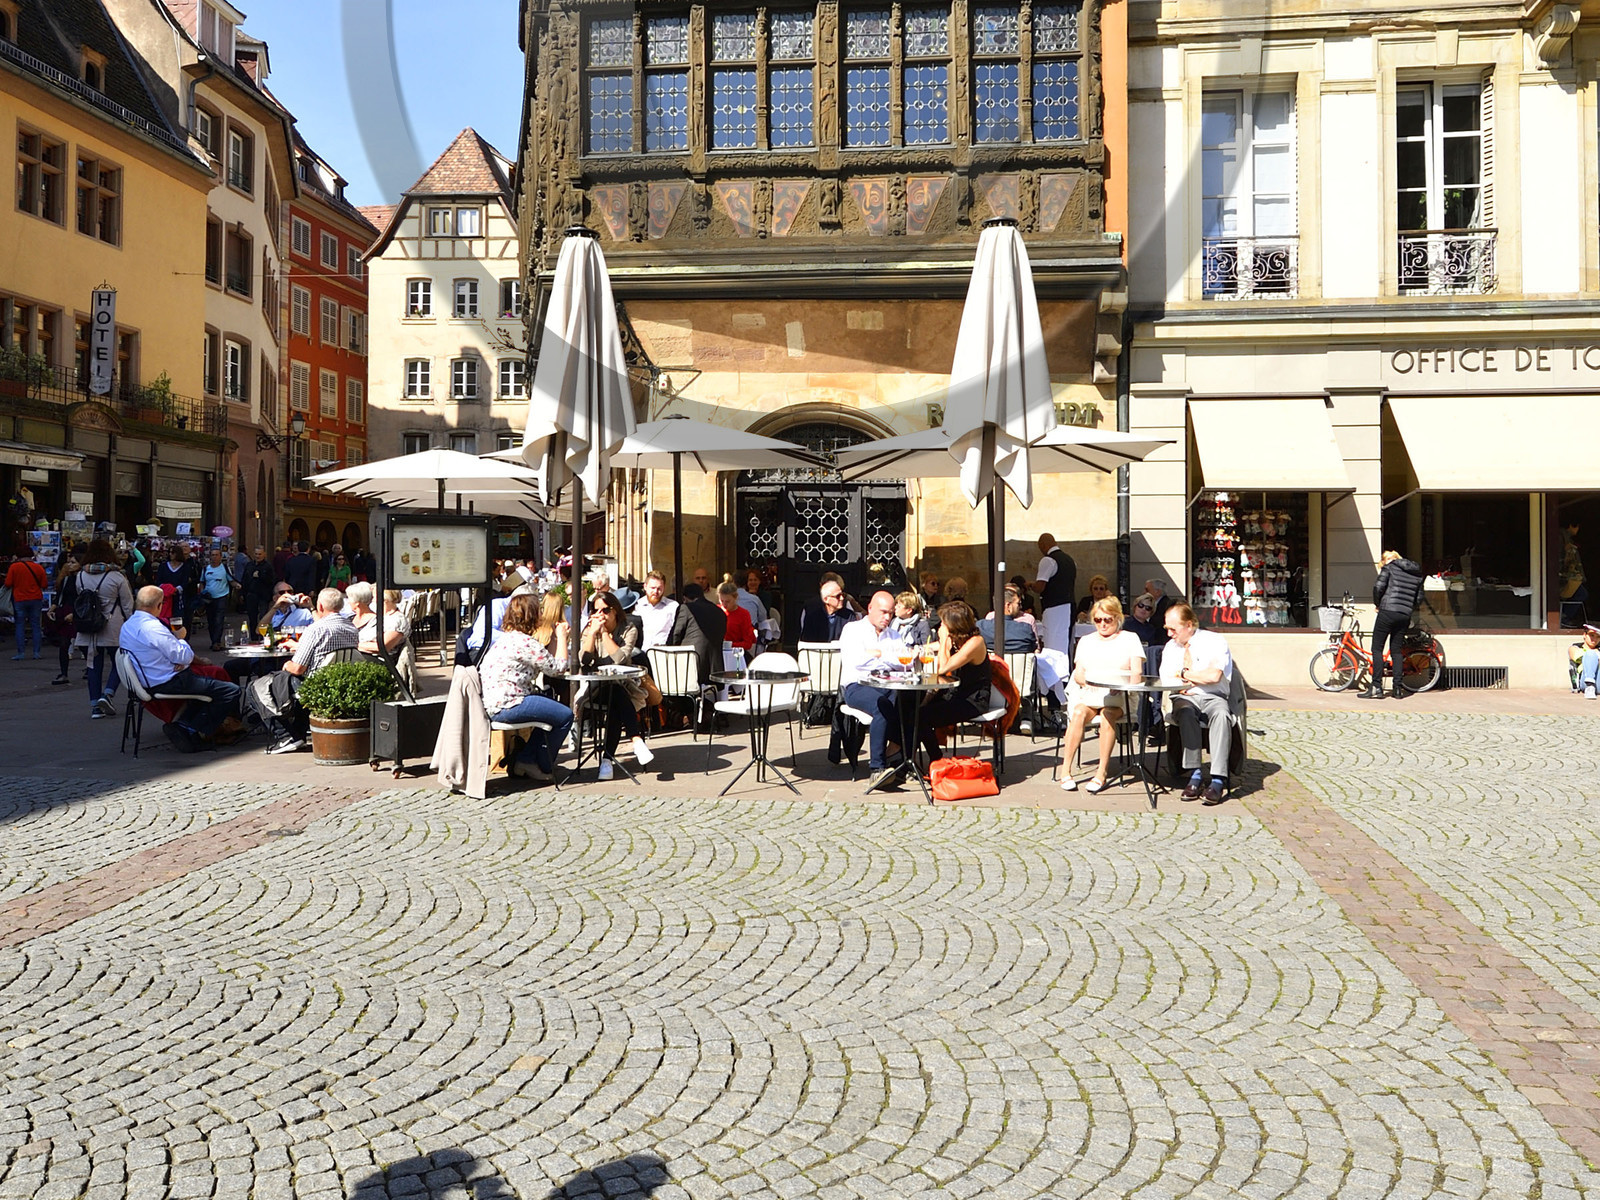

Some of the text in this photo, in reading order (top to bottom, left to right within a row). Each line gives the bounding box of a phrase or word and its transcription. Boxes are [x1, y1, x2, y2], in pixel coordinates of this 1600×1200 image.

[95, 293, 111, 378] HOTEL
[1390, 346, 1498, 374] OFFICE
[1514, 346, 1551, 372] DE
